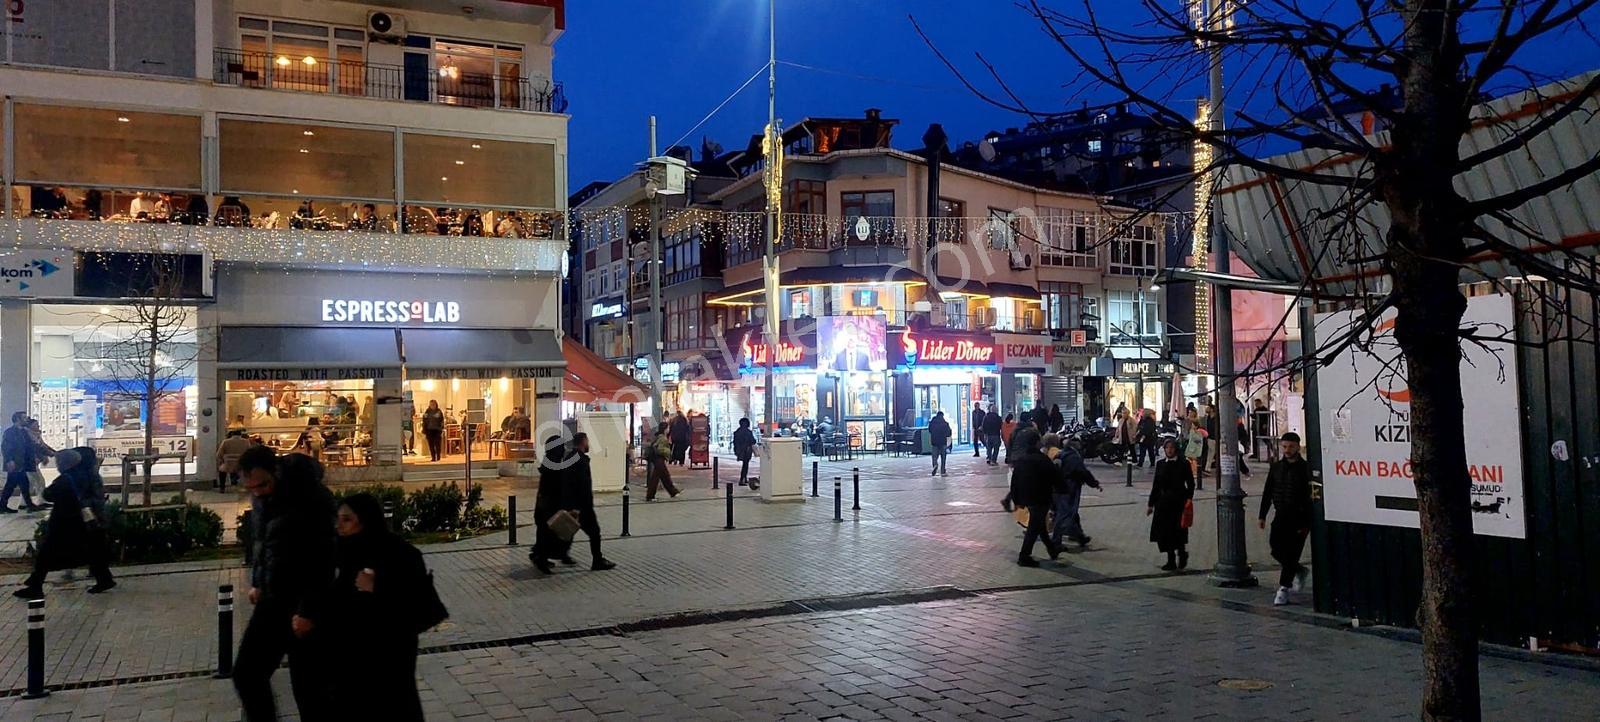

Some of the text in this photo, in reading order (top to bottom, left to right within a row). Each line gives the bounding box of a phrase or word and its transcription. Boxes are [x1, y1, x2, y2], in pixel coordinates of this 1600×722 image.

[322, 299, 461, 323] ESPRESSOLAB
[775, 341, 803, 363] Döner
[919, 339, 993, 361] Lider Döner
[1006, 343, 1044, 358] ECZANE
[237, 367, 384, 380] ROASTED WITH PASSION
[422, 368, 468, 379] ROASTED
[511, 367, 552, 378] PASSION
[1375, 425, 1411, 443] KIZI
[168, 440, 187, 451] 12
[1335, 458, 1503, 483] KAN BAĞ ANI
